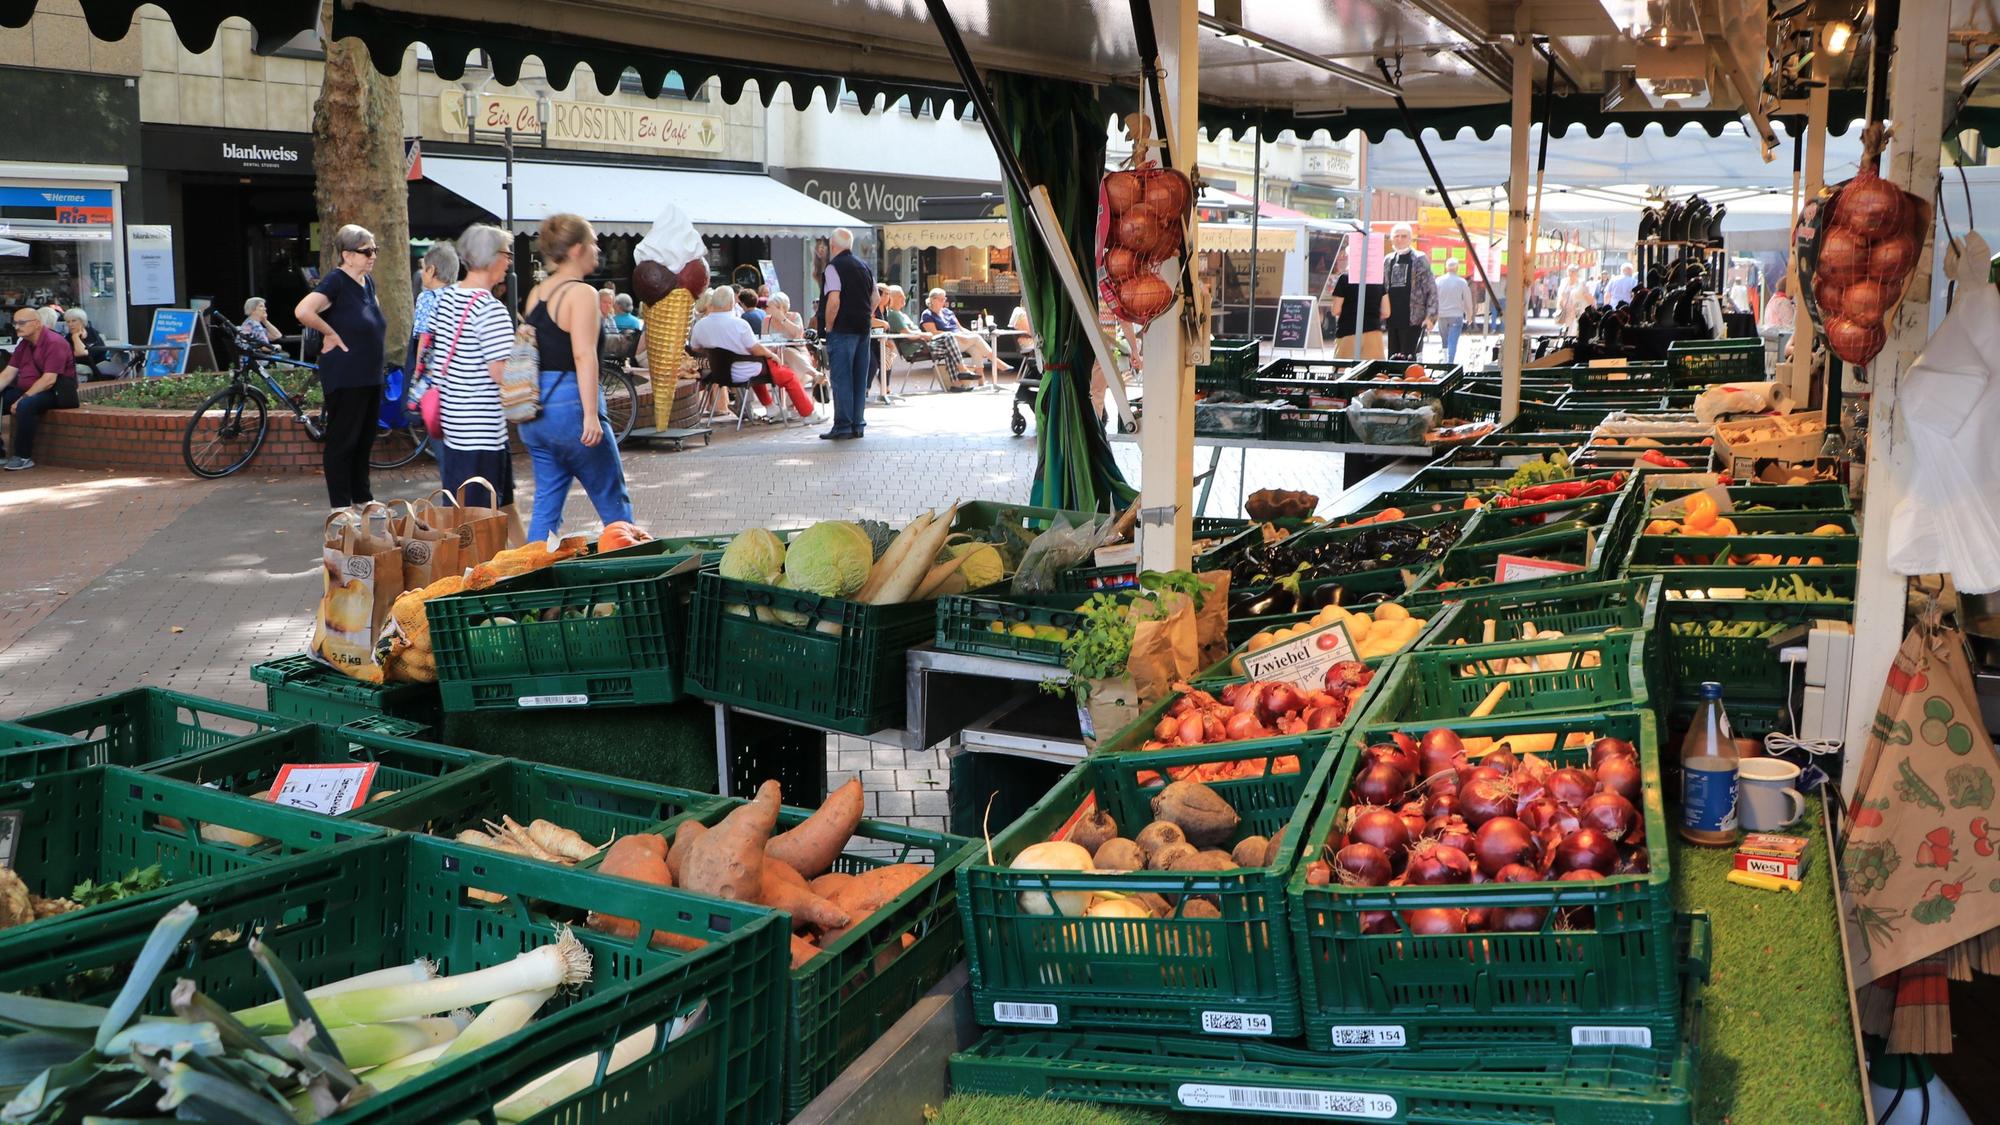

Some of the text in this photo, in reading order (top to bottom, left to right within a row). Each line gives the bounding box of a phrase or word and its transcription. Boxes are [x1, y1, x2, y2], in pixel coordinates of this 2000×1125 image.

[487, 102, 511, 127] Eis
[555, 103, 634, 142] ROSSINI
[638, 116, 657, 138] Eis
[223, 143, 298, 161] blankweiss
[52, 193, 86, 203] Hermes
[847, 181, 861, 210] &
[59, 206, 88, 224] Ria
[332, 652, 362, 666] 2,5 kg
[1250, 646, 1312, 677] Zwiebel
[1750, 861, 1780, 874] West
[1247, 1017, 1267, 1027] 154
[1380, 1030, 1400, 1041] 154
[1369, 1100, 1393, 1113] 136
